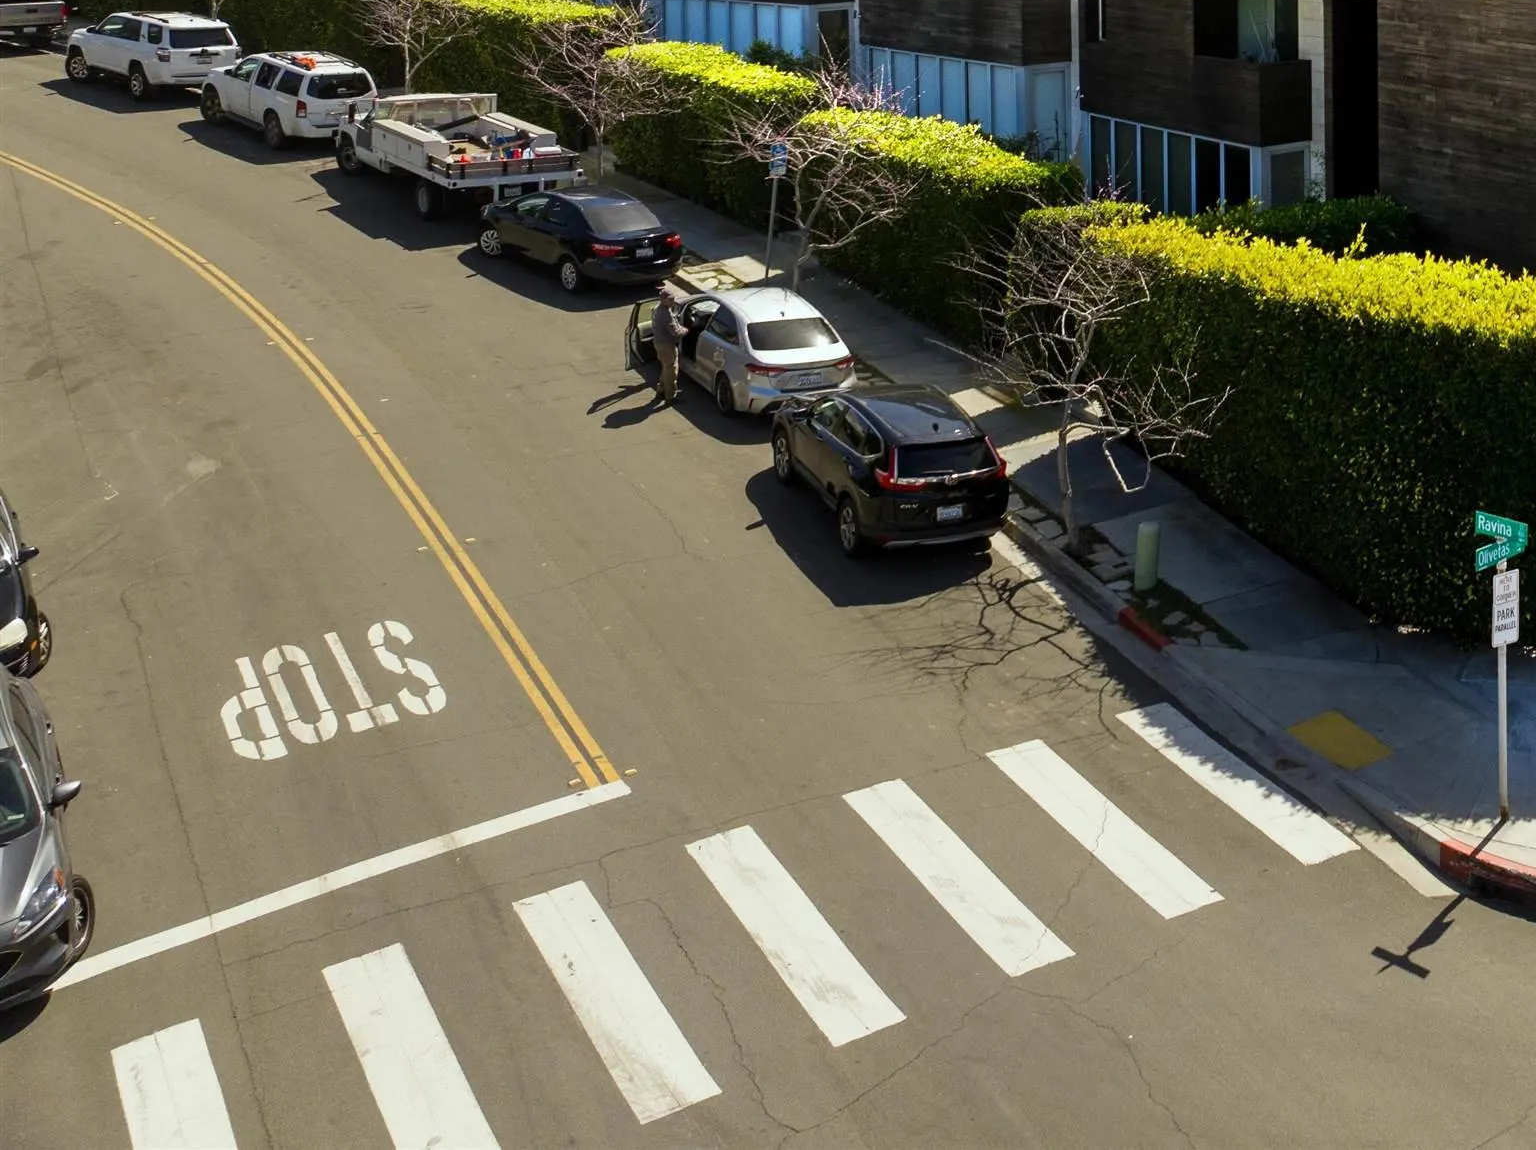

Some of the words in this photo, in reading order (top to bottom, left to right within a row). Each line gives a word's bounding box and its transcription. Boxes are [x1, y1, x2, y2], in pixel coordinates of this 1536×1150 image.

[1478, 515, 1512, 538] Ravina
[1478, 543, 1510, 566] Olivetas
[1503, 584, 1510, 592] TO
[1496, 606, 1515, 621] PARK
[1495, 621, 1516, 633] PARALLEL
[220, 620, 447, 761] STOP
